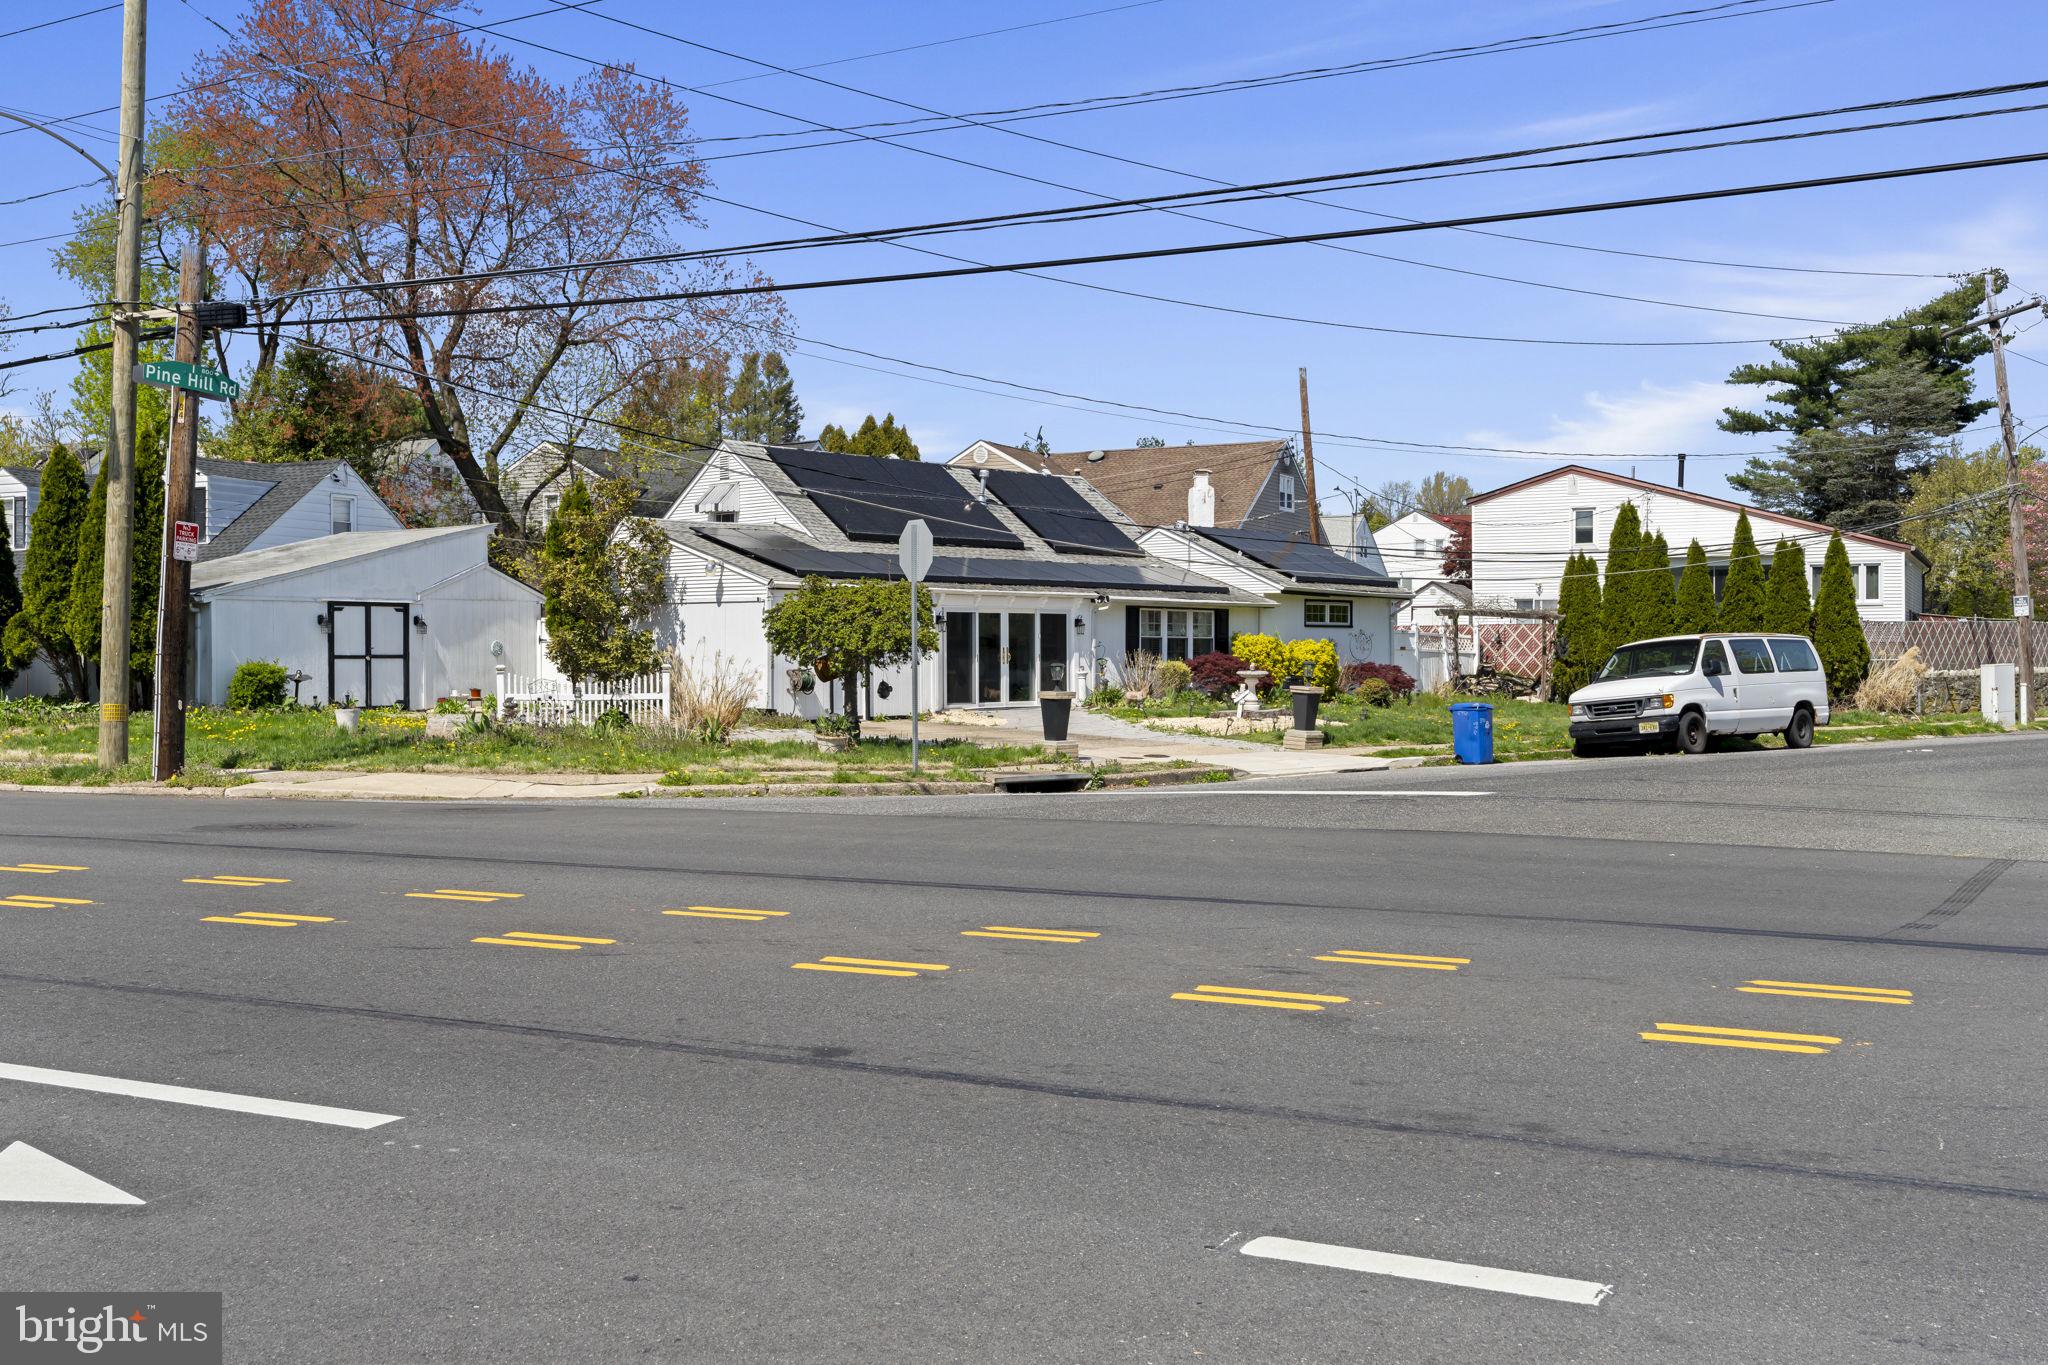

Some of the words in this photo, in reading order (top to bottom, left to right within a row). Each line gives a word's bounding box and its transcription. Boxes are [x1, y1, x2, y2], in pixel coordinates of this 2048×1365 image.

[146, 365, 181, 384] Pine
[188, 373, 213, 392] Hill
[220, 381, 236, 396] Rd
[177, 535, 196, 543] PARKING
